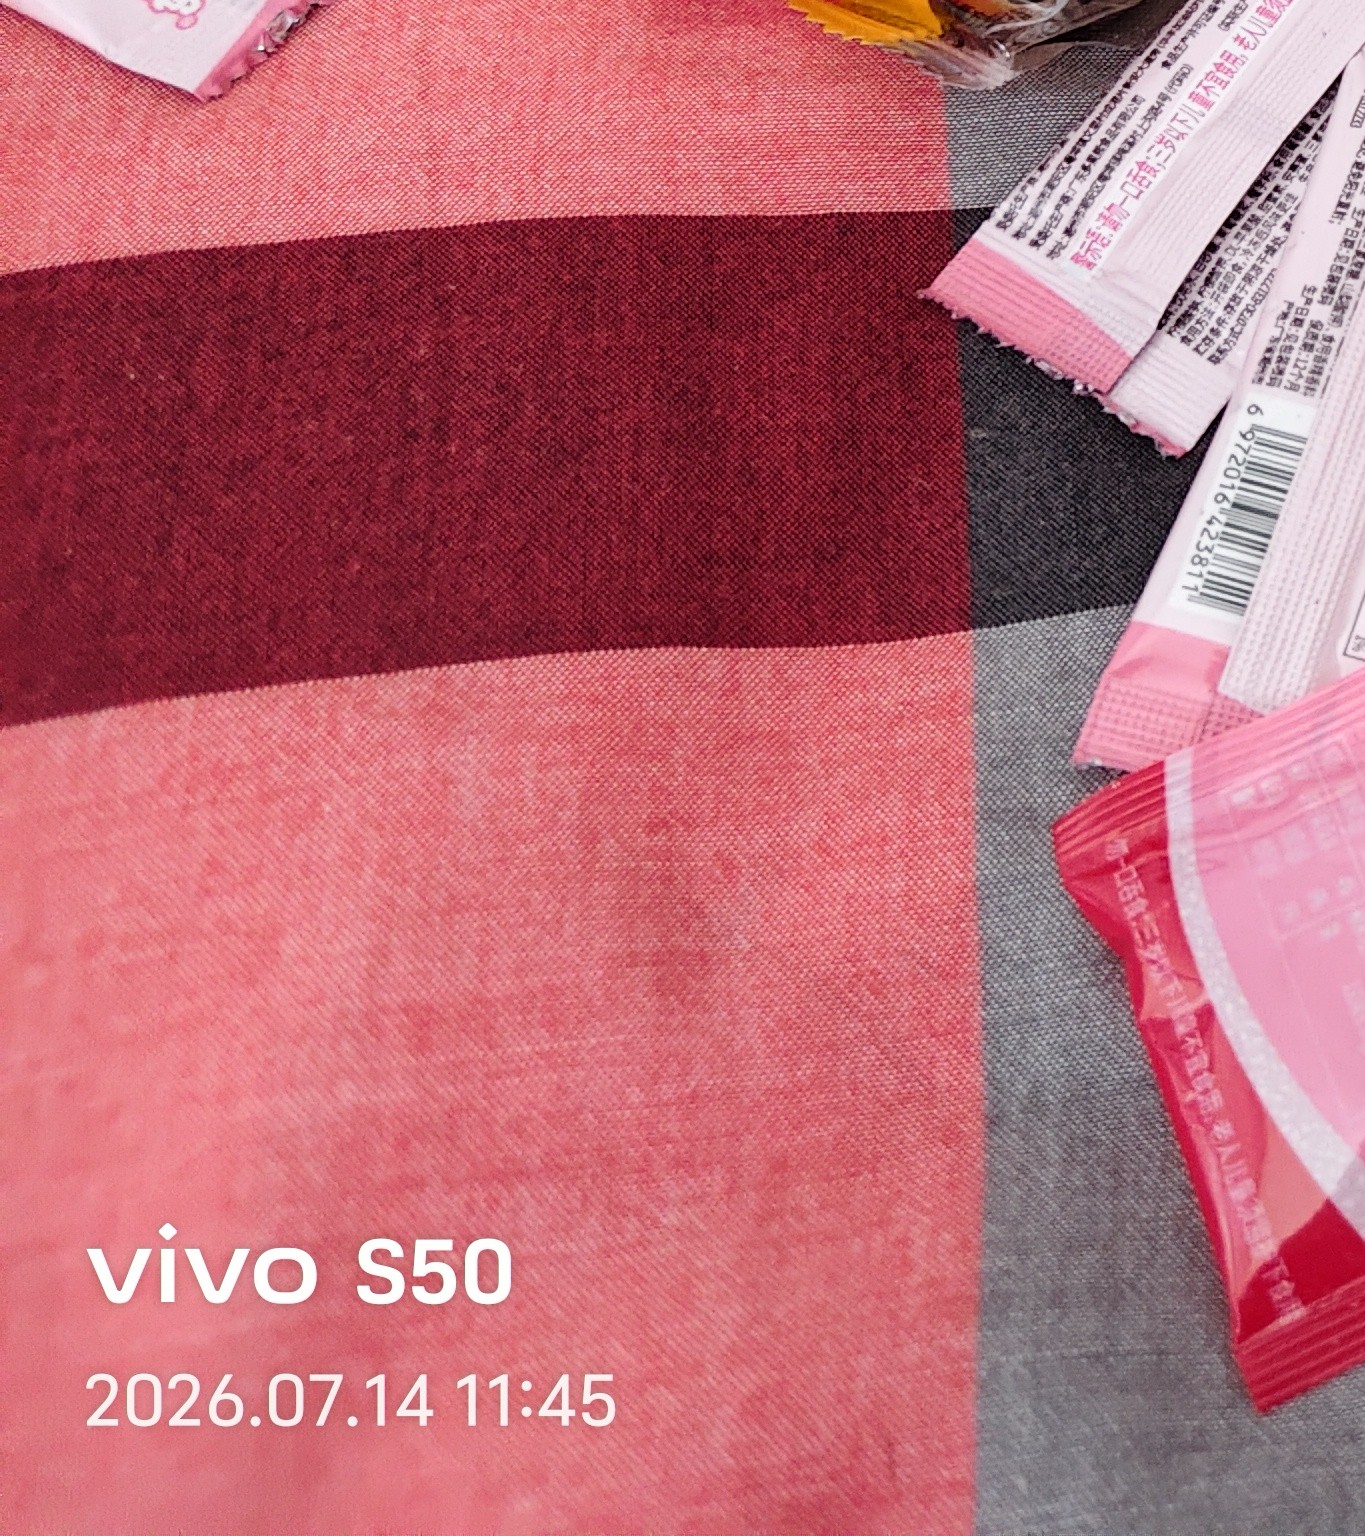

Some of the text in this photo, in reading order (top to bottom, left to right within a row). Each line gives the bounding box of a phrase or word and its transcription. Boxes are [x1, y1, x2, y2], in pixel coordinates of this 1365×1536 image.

[1180, 401, 1262, 595] 6 972016 423811
